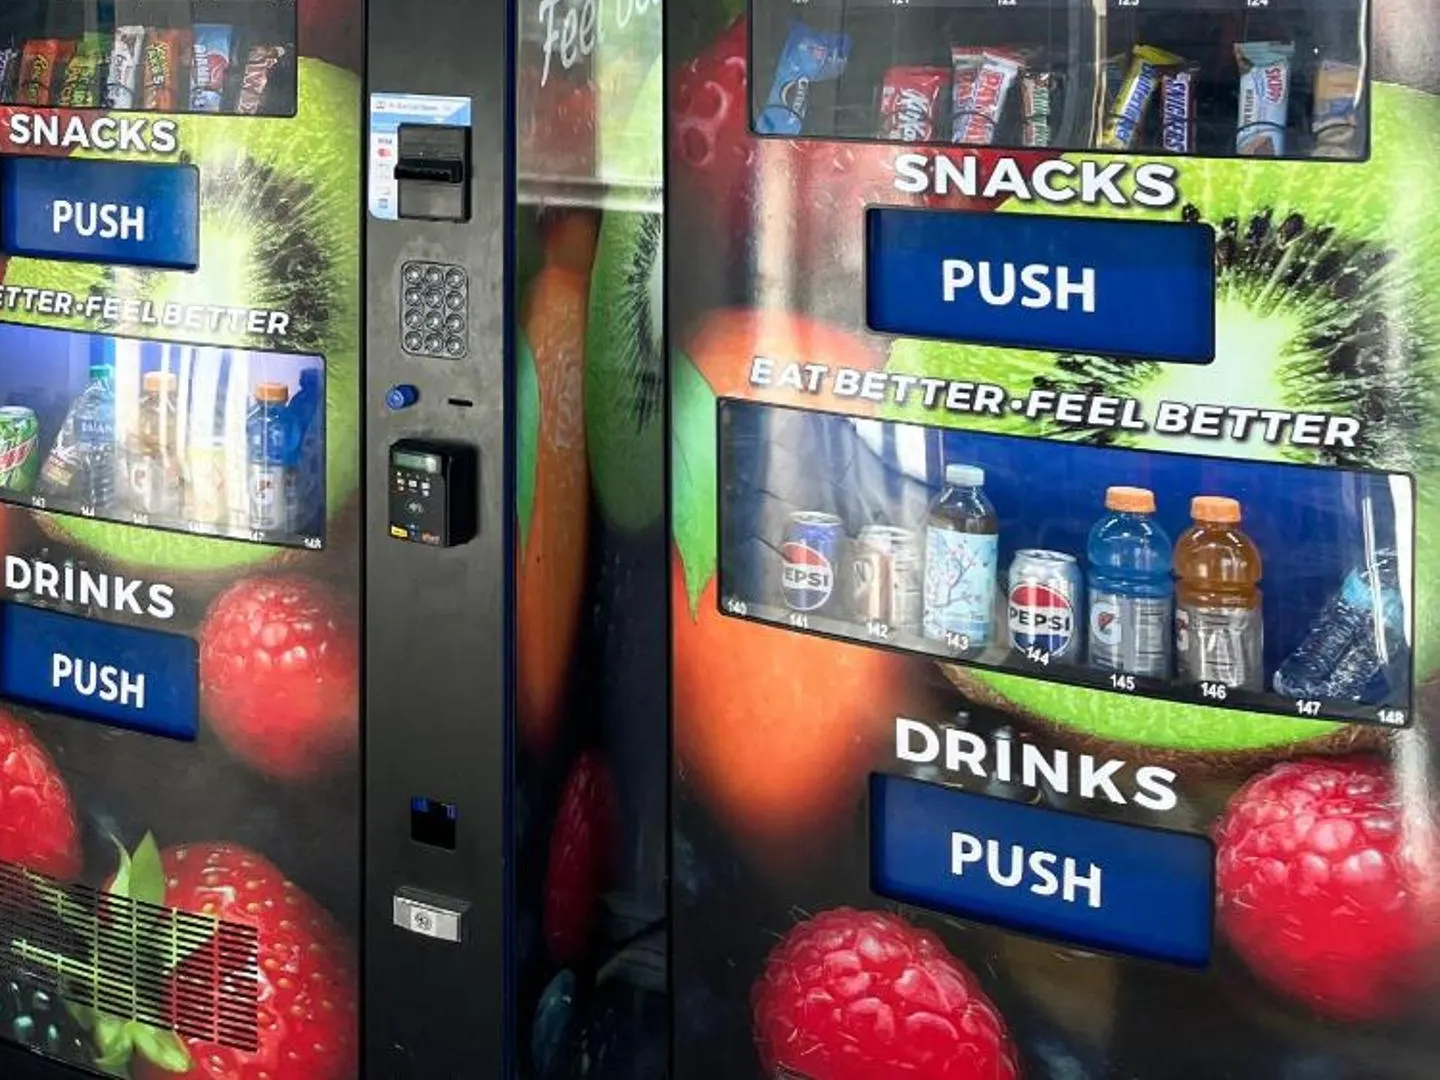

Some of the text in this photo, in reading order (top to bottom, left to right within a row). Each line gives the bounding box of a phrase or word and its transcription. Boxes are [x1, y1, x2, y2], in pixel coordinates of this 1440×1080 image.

[1265, 66, 1286, 105] SKIPPY
[1164, 79, 1188, 152] SNICKERS
[10, 114, 177, 151] SNACKS
[894, 153, 1176, 206] SNACKS
[53, 200, 145, 241] PUSH
[943, 259, 1096, 312] PUSH
[165, 306, 290, 336] BETTER
[750, 356, 827, 393] EAT
[1156, 400, 1360, 447] BETTER
[80, 505, 95, 517] 144
[5, 555, 175, 618] DRINKS
[783, 568, 829, 588] EPSI
[789, 614, 808, 628] 141
[866, 622, 888, 639] 142
[1010, 608, 1071, 631] PEPSI
[944, 630, 969, 650] 143
[1024, 646, 1049, 666] 144
[53, 653, 145, 709] PUSH
[1110, 674, 1135, 690] 145
[1200, 682, 1227, 700] 146
[1295, 700, 1321, 716] 147
[1377, 710, 1404, 725] 148
[896, 717, 1178, 810] DRINKS
[951, 831, 1102, 908] PUSH
